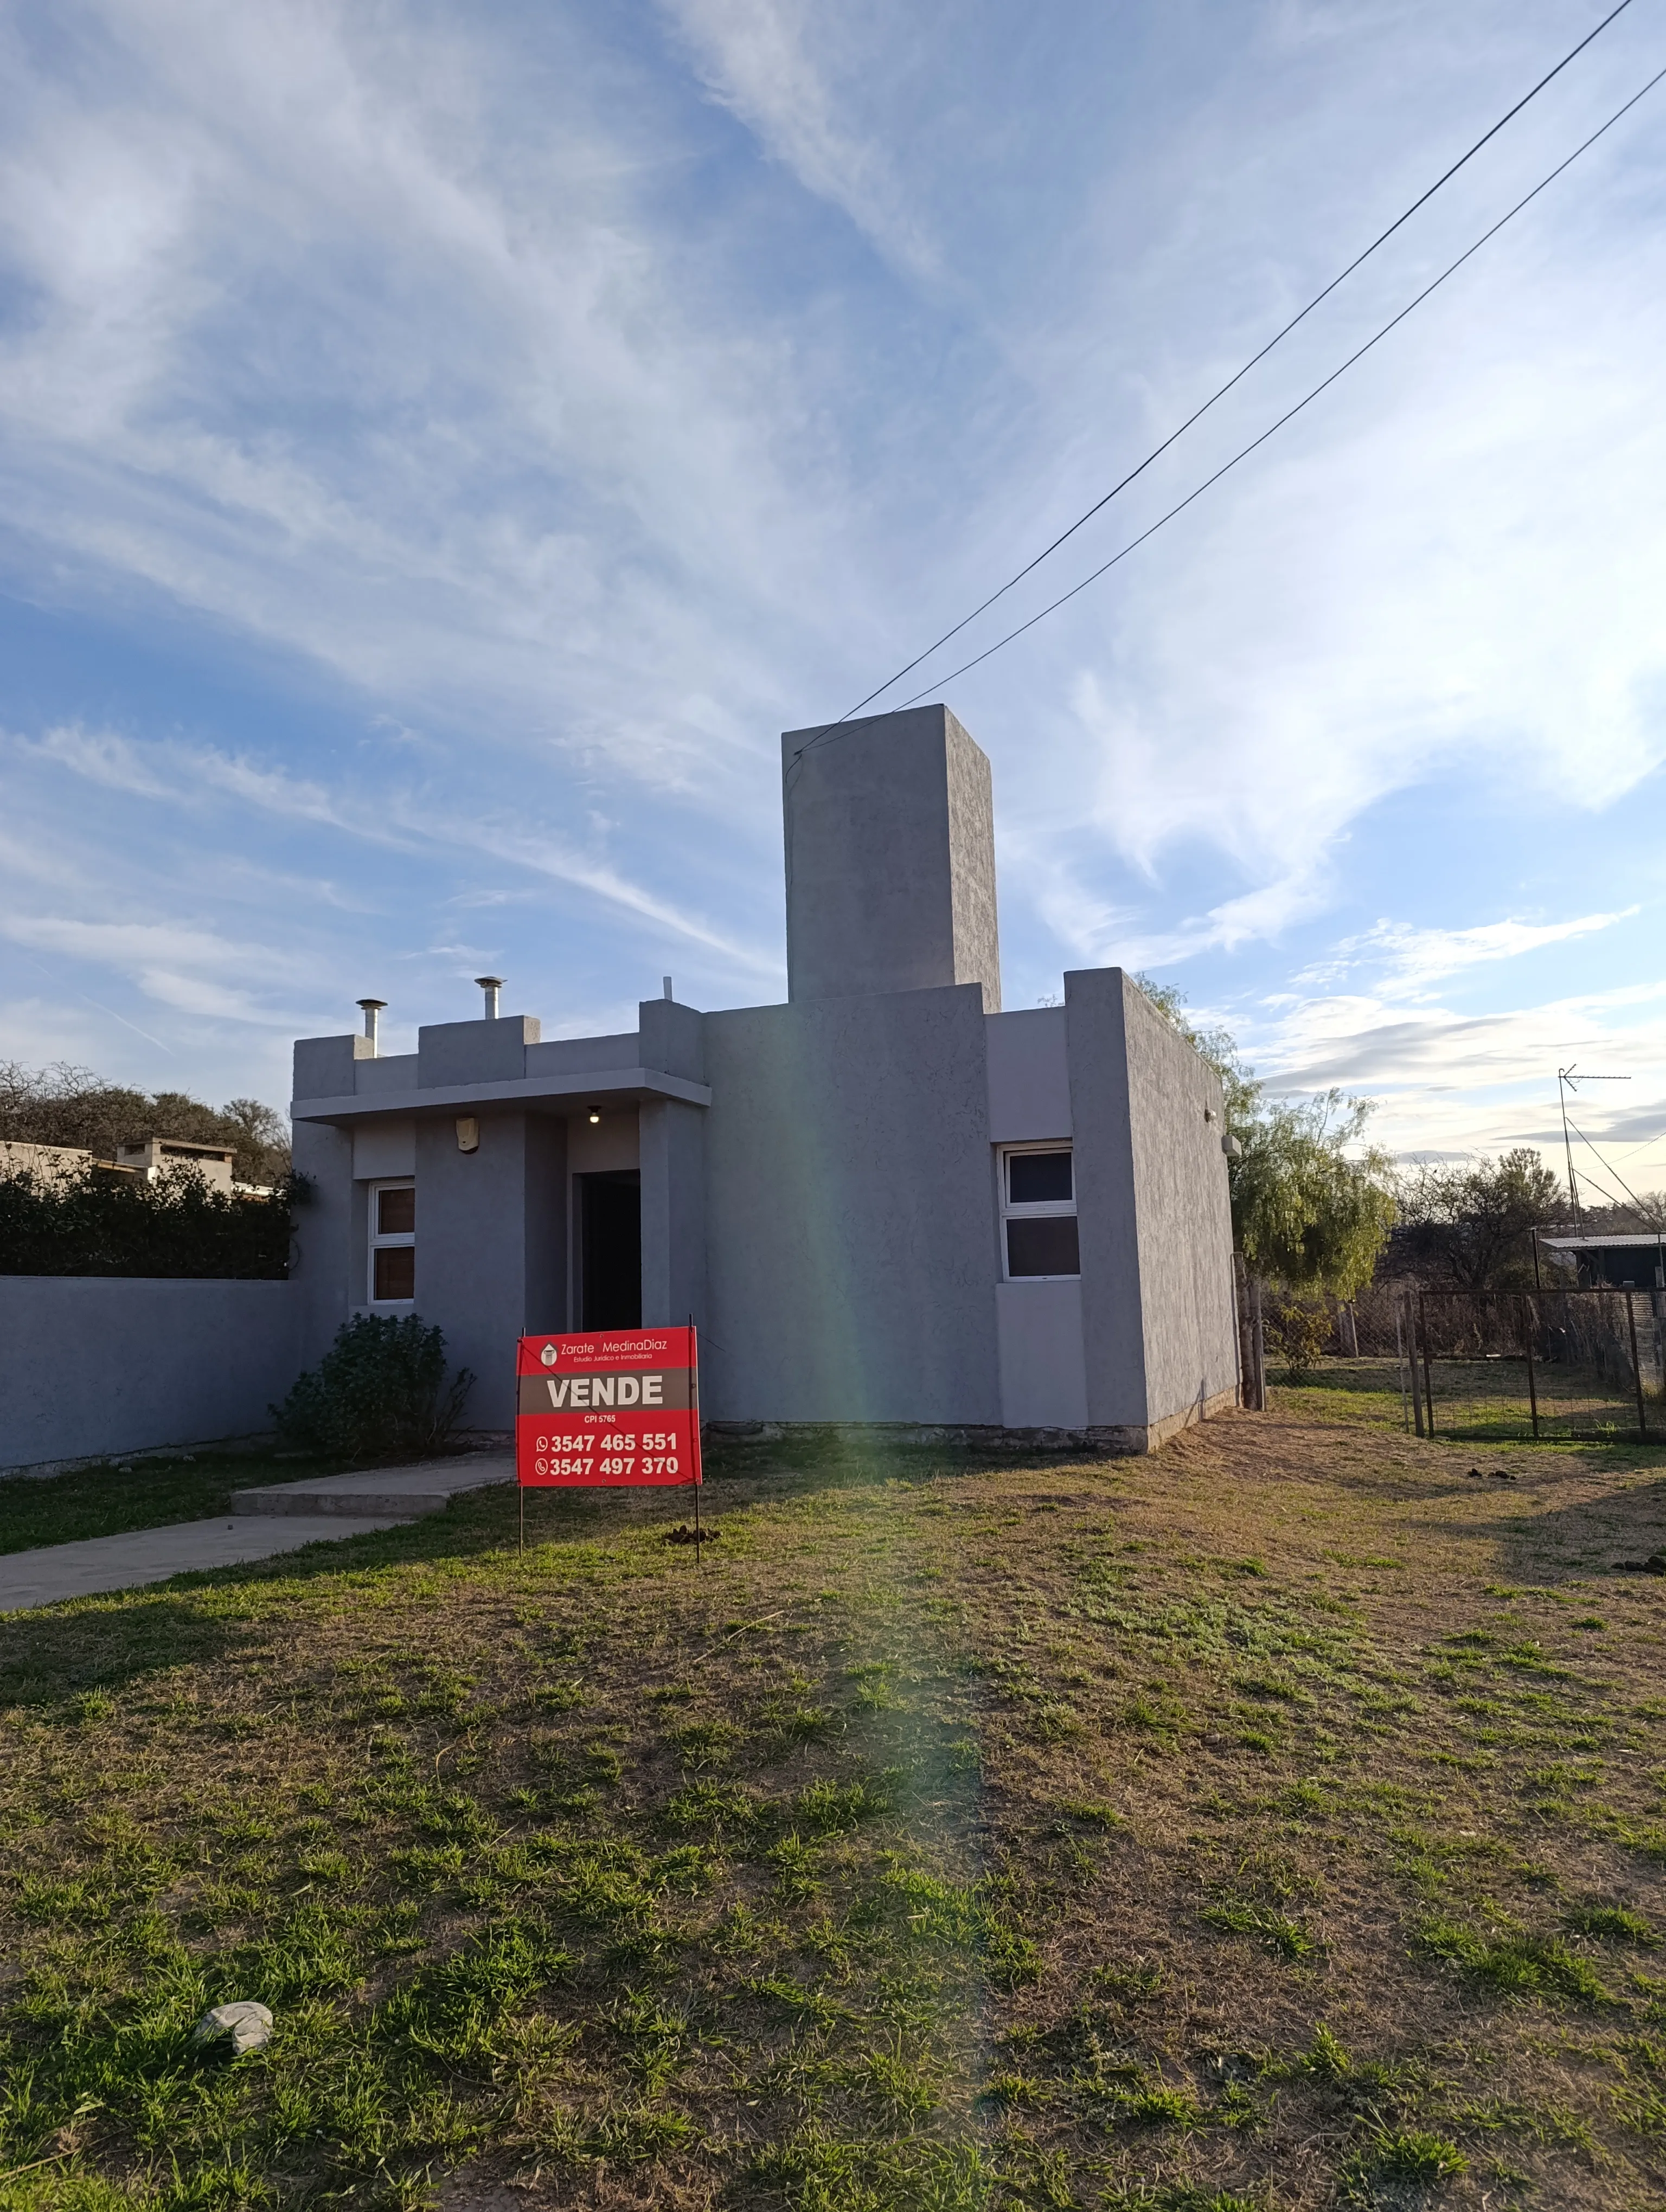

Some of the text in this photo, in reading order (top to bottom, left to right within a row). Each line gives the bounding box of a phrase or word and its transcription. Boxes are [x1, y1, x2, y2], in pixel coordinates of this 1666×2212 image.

[561, 1343, 594, 1355] Zarate
[547, 1375, 663, 1407] VENDE
[599, 1414, 616, 1423] 5765
[551, 1433, 676, 1452] 3547 465 551
[550, 1457, 678, 1475] 3547 497 370
